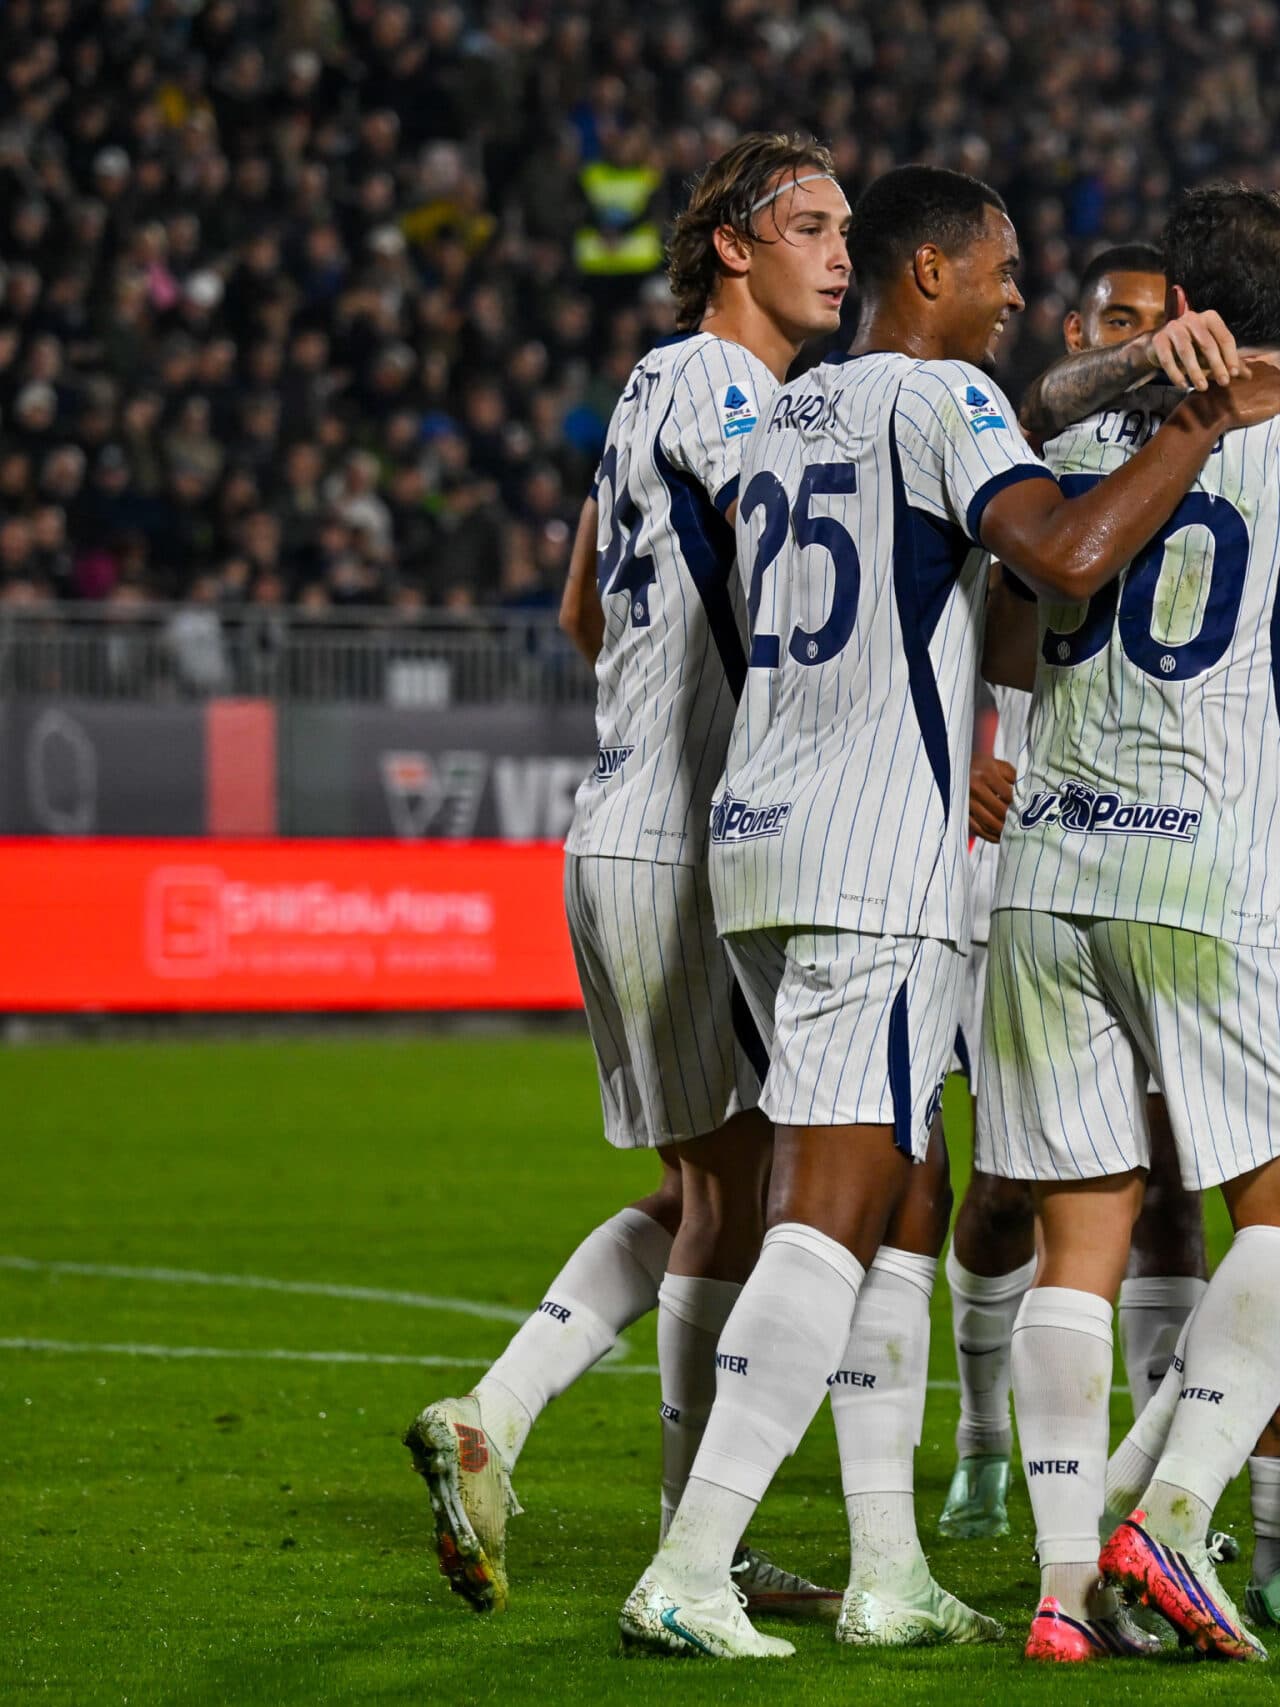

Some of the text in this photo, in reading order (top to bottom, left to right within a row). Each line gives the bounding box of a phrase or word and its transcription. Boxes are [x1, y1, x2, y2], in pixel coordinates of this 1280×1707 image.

[740, 462, 860, 668] 25
[1090, 792, 1201, 838] Power
[713, 1352, 748, 1376] NTER
[1179, 1387, 1224, 1404] NTER
[1028, 1459, 1079, 1476] INTER
